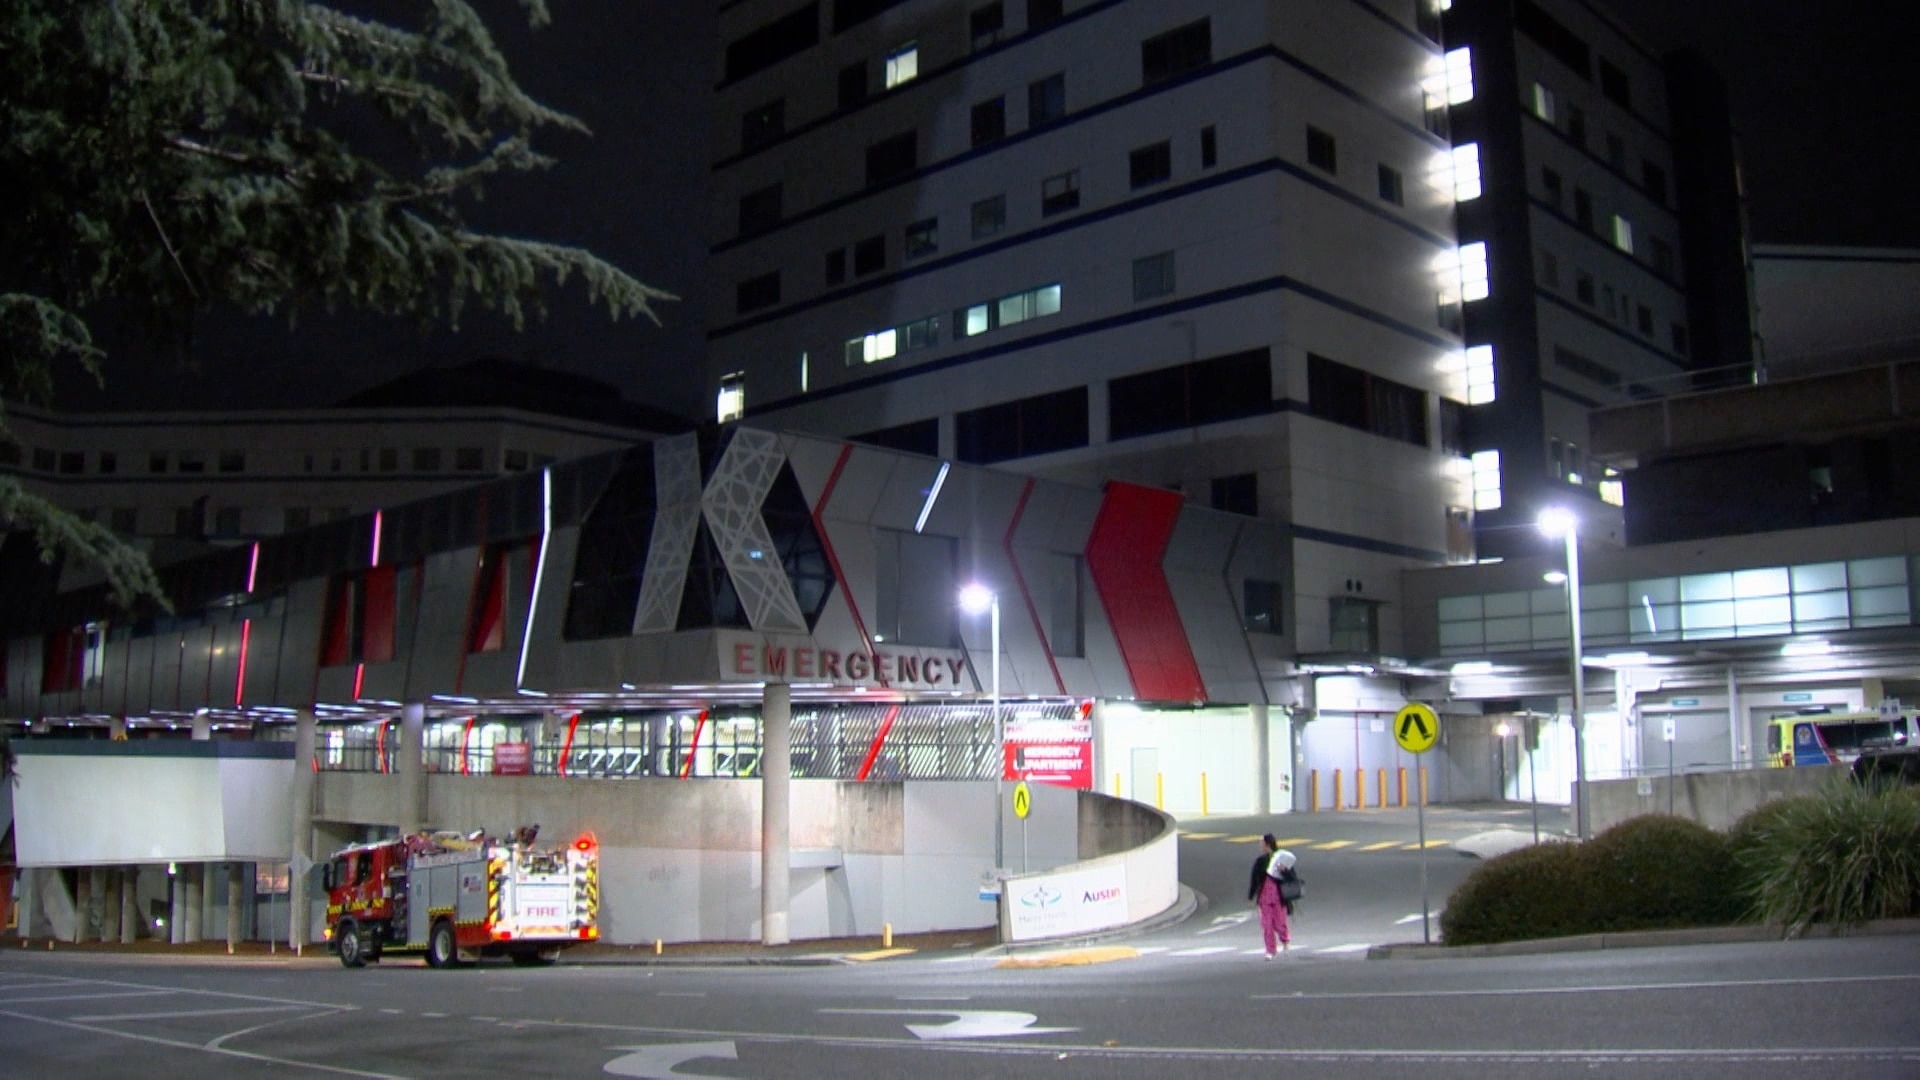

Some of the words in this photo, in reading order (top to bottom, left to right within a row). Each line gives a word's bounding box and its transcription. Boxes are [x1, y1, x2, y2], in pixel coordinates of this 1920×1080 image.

[735, 643, 967, 685] EMERGENCY
[1082, 887, 1121, 904] Austin
[527, 906, 560, 917] FIRE
